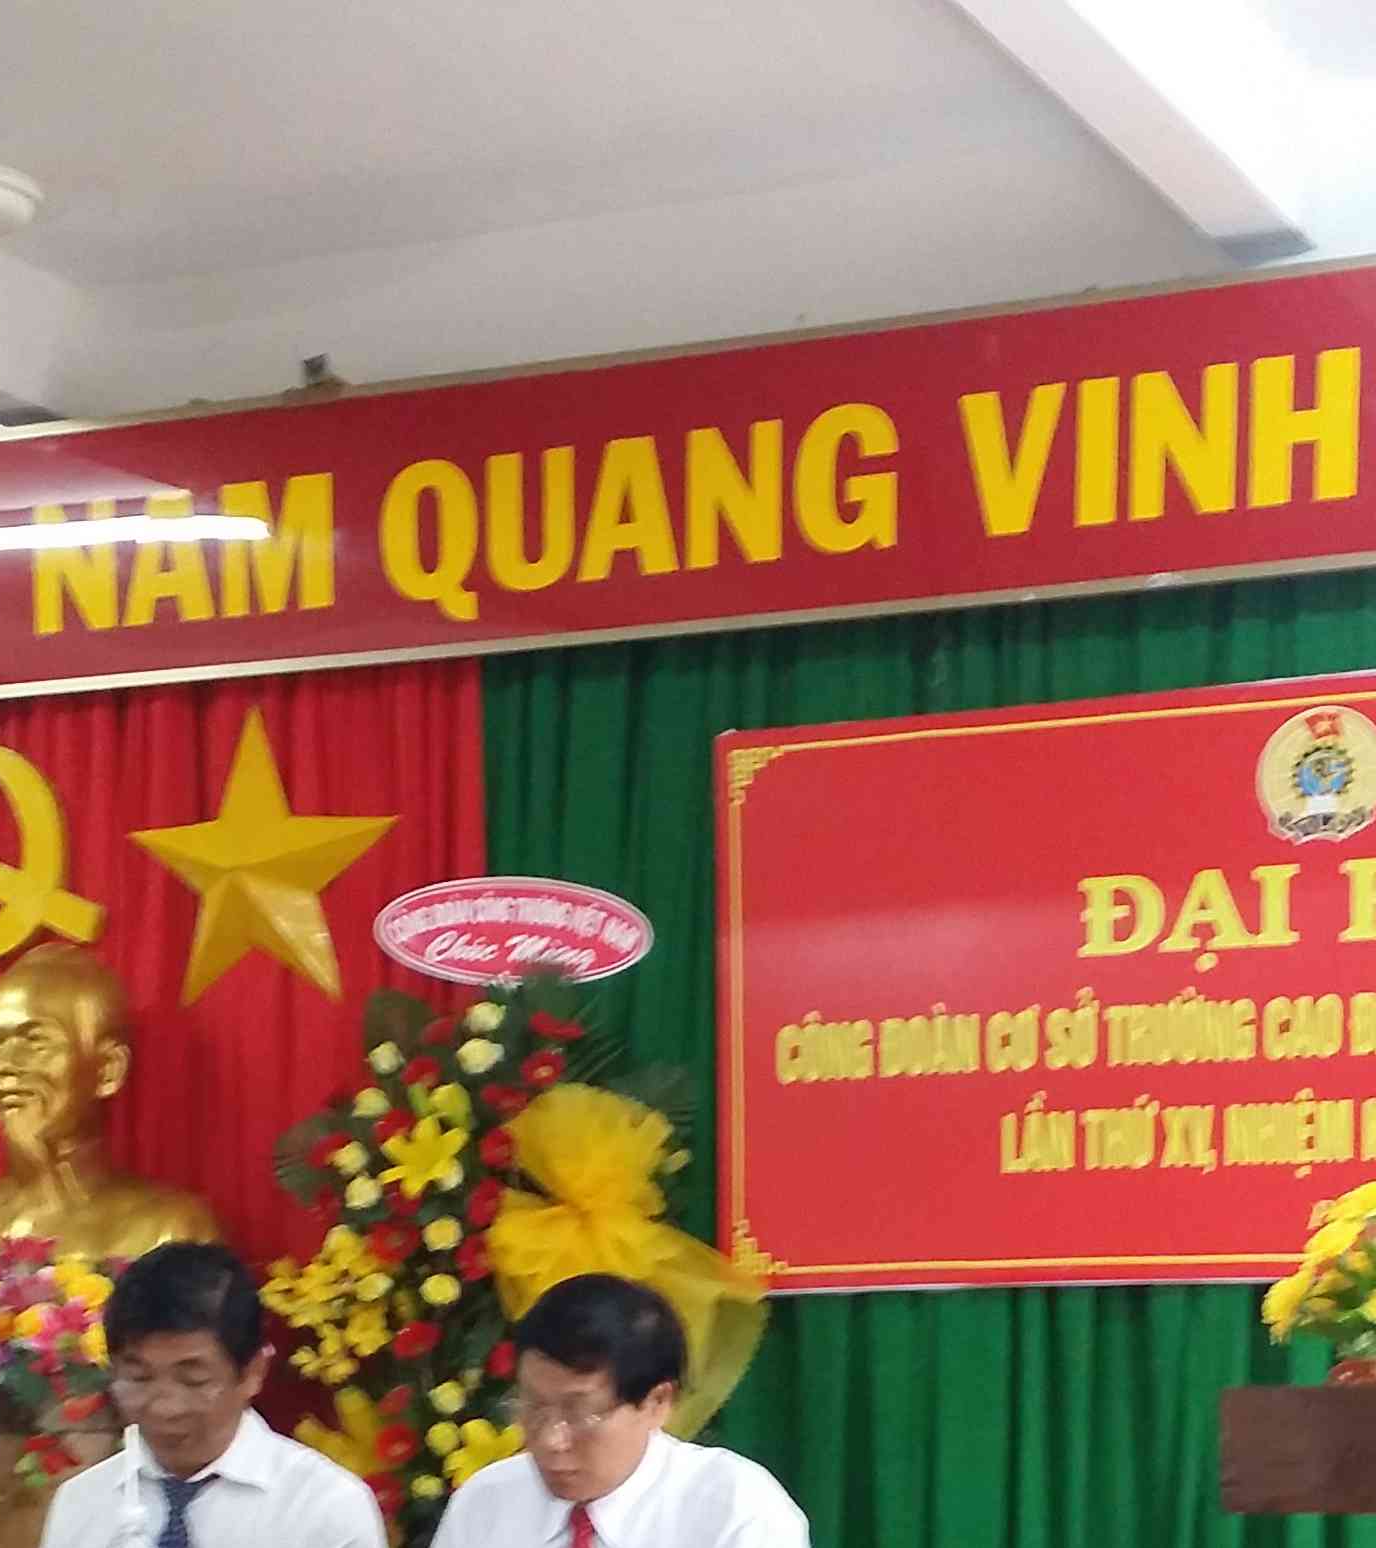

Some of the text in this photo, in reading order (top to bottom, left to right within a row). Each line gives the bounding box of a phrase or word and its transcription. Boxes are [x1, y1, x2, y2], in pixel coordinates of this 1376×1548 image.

[31, 472, 336, 638] NAM
[379, 403, 900, 621] QUANG
[959, 346, 1361, 538] VINH
[1077, 863, 1301, 973] ĐẠI
[775, 1009, 875, 1085] CÔNG
[985, 1003, 1041, 1073] CƠ
[1044, 985, 1100, 1069] SỞ
[1103, 985, 1258, 1067] TRƯỜNG
[1262, 994, 1345, 1062] CAO
